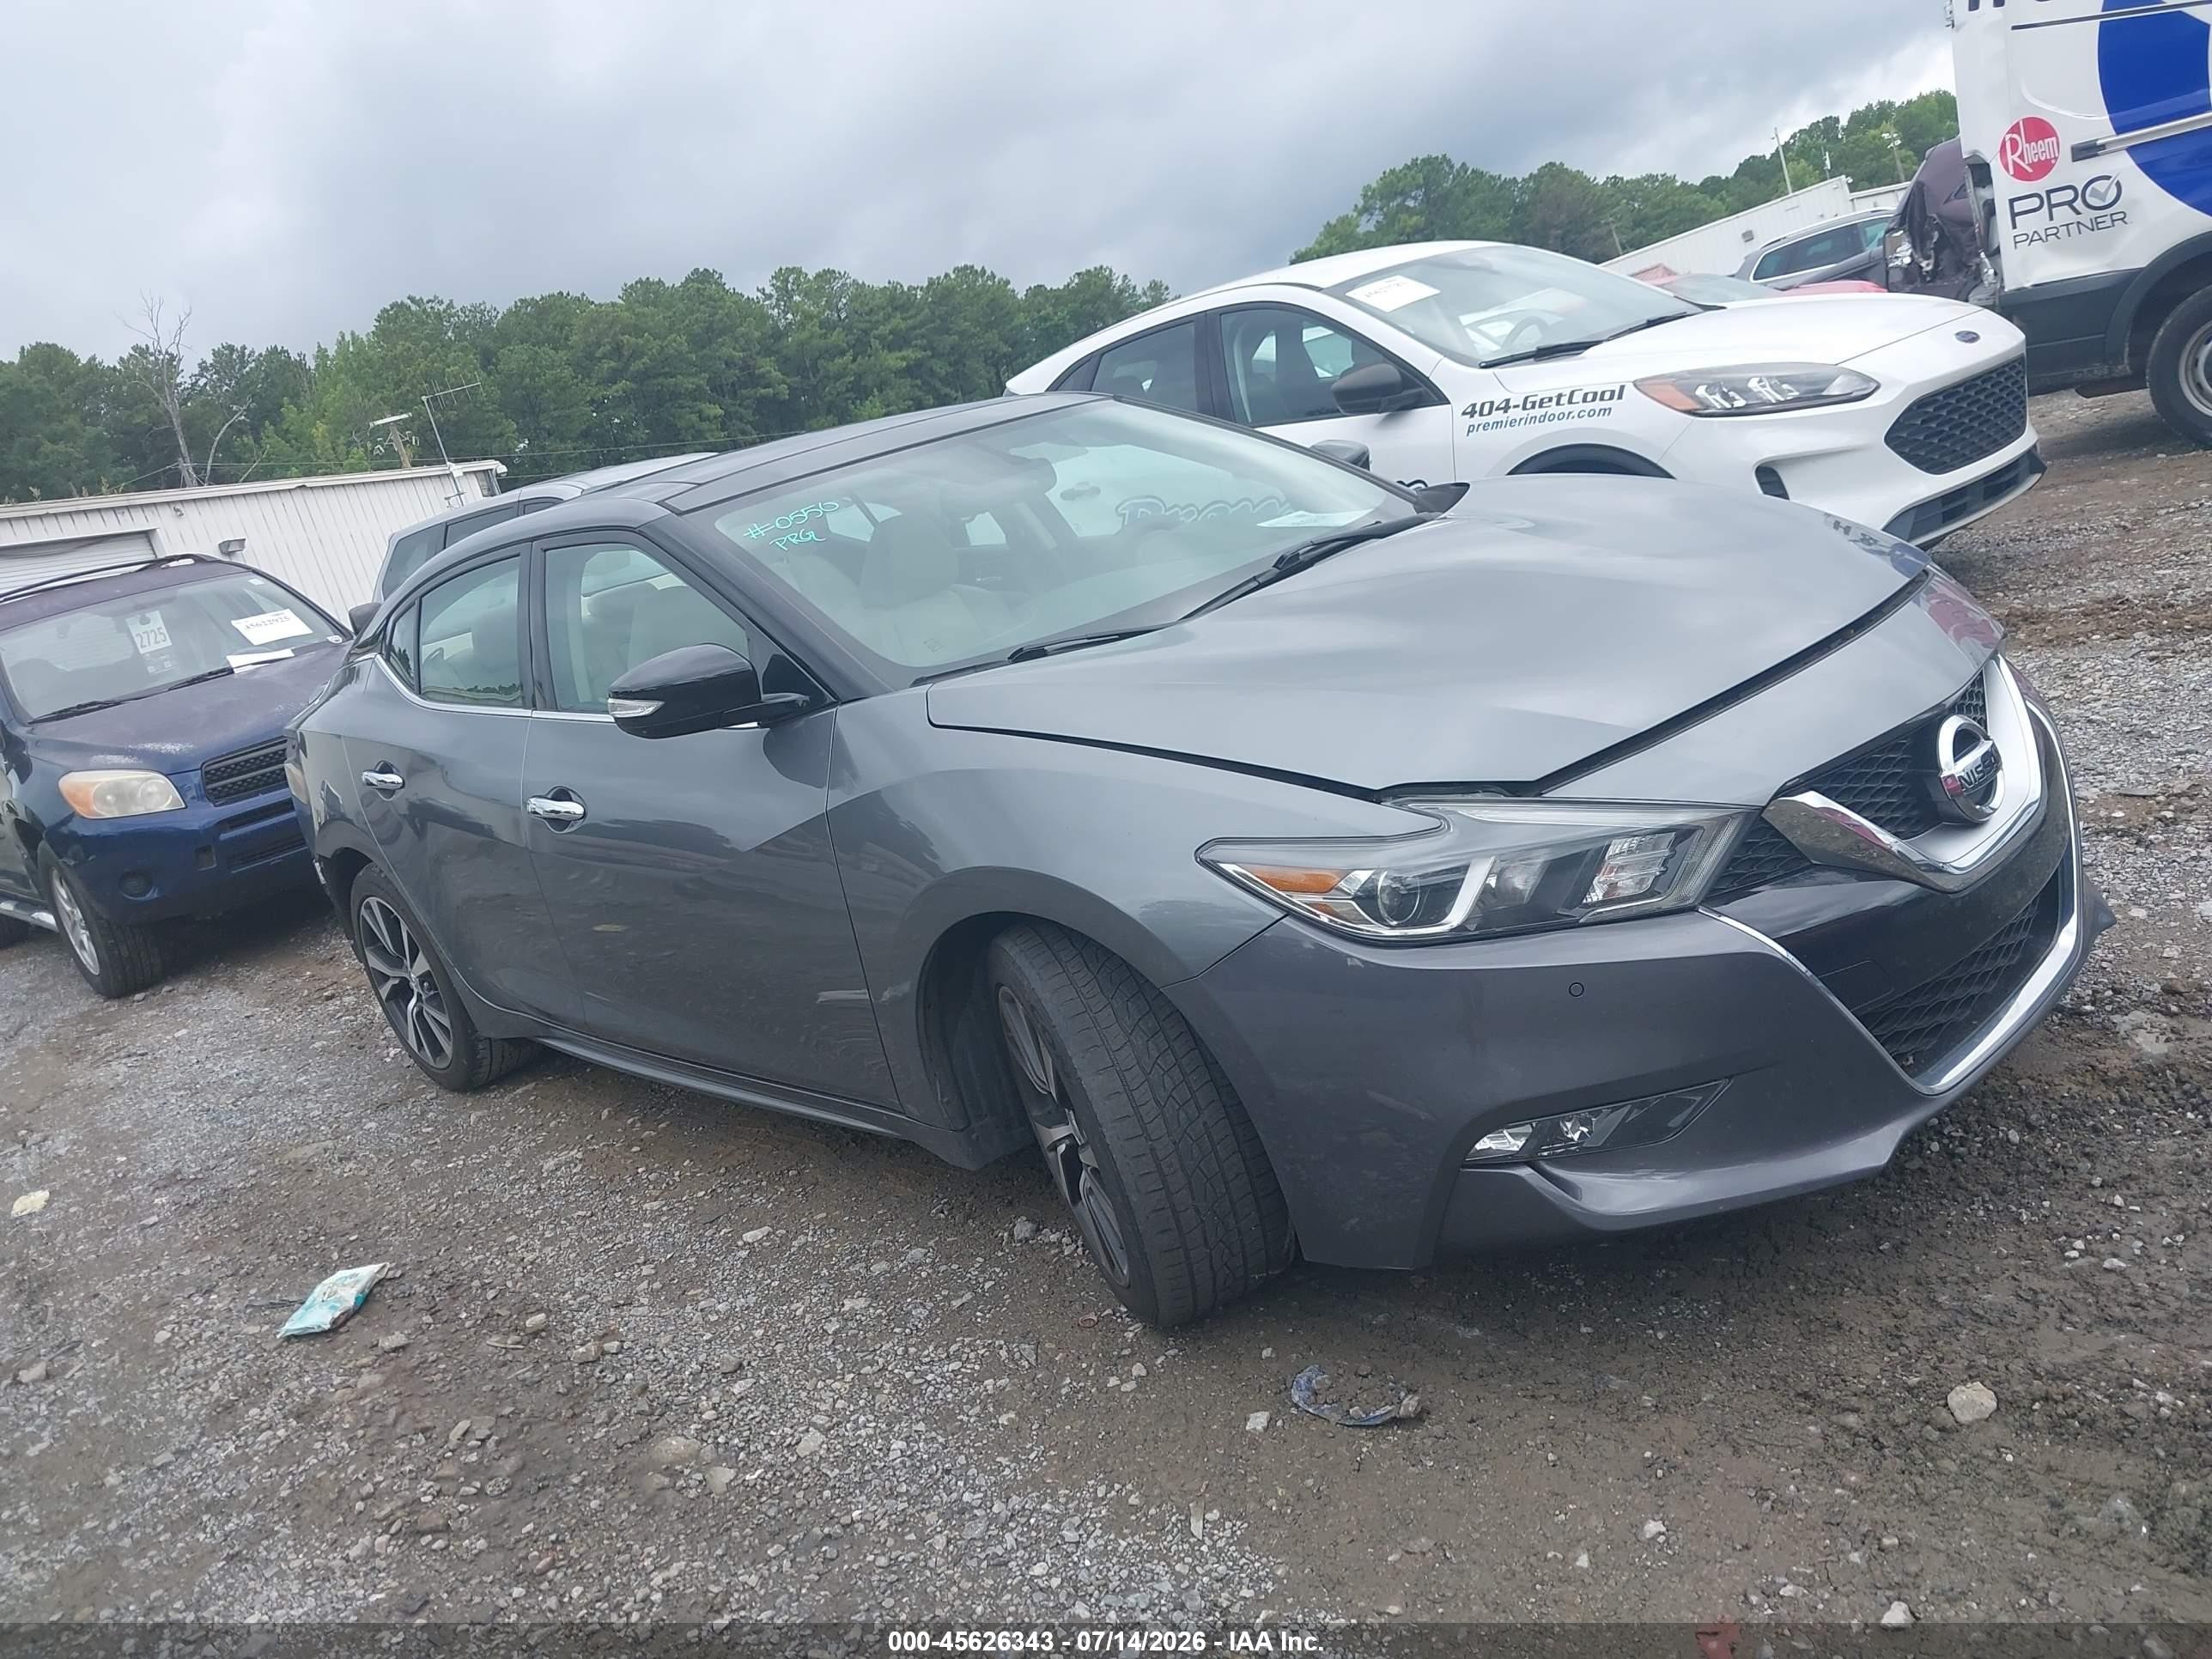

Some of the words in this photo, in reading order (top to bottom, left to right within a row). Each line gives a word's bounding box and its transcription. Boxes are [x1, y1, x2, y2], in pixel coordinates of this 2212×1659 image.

[2004, 118, 2059, 175] Rheem
[2008, 173, 2123, 230] PRO
[2013, 210, 2129, 250] PARTNER
[1461, 384, 1626, 419] 404-GetCool
[1466, 406, 1613, 437] premierindoor.com
[135, 626, 168, 649] 2725
